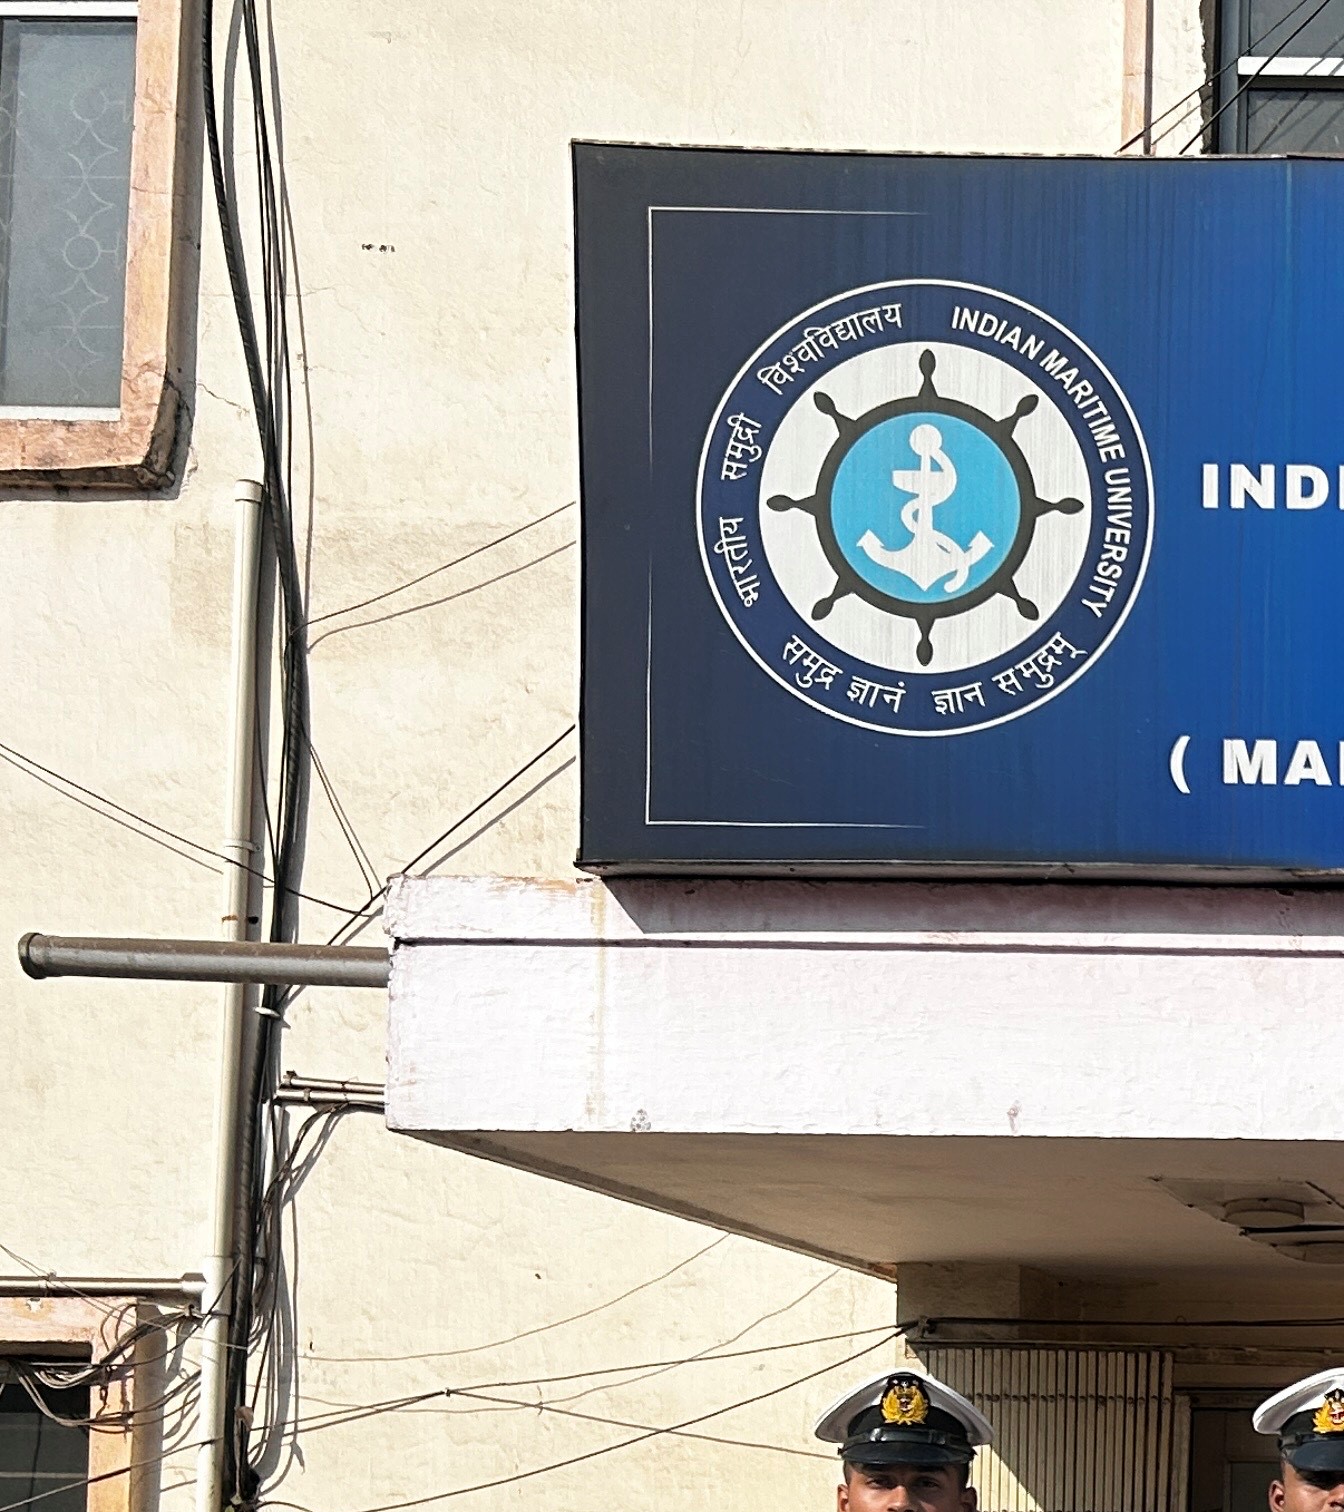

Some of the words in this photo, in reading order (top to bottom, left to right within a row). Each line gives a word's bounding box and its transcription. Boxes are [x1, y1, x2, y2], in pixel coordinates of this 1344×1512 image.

[757, 303, 903, 396] विश्वविद्यालय
[951, 306, 1045, 361] INDIAN
[720, 412, 763, 482] समुद्री
[1039, 349, 1126, 463] MARITIME
[713, 517, 761, 608] भारतीय
[1081, 468, 1133, 618] UNIVERSITY
[782, 634, 843, 691] समुद्र
[846, 681, 907, 713] ज्ञानं
[931, 681, 986, 715] ज्ञान
[991, 631, 1088, 697] समुद्रम्
